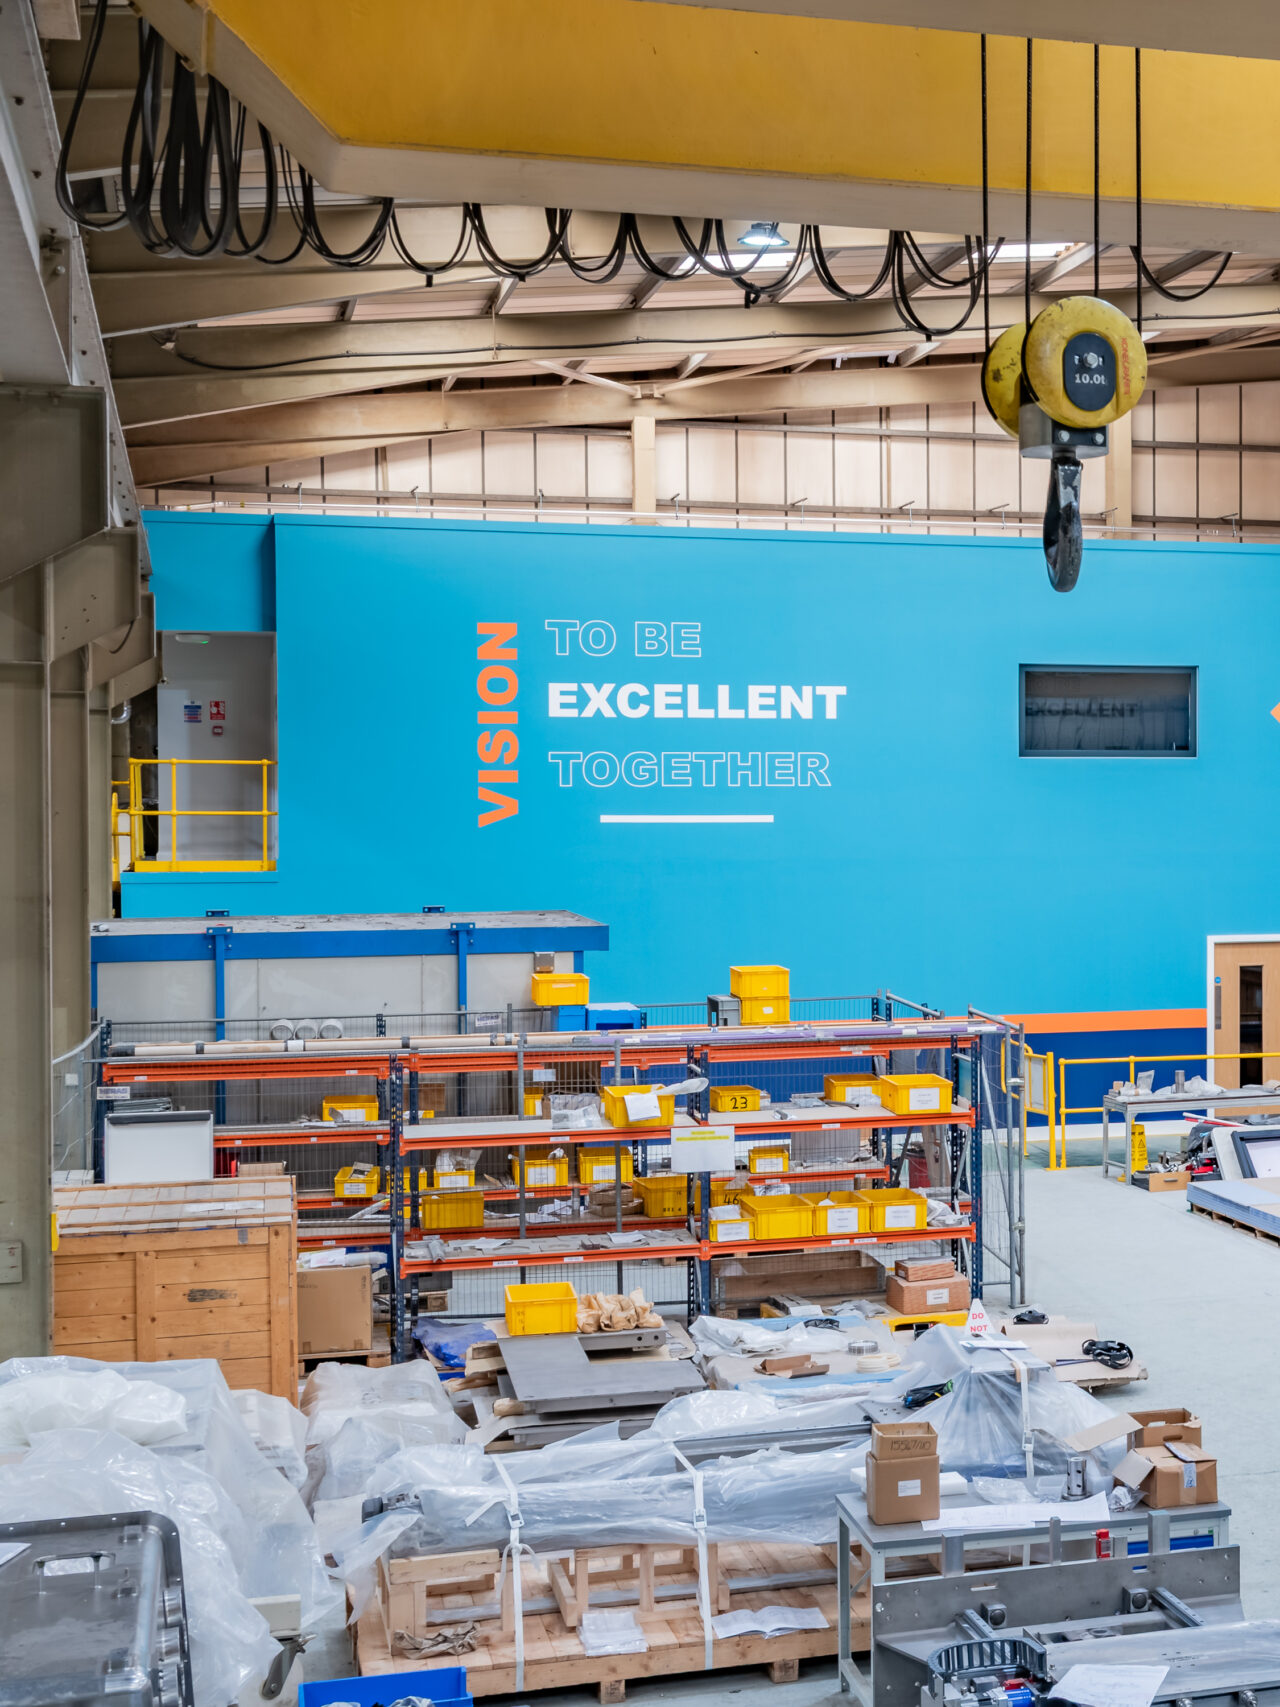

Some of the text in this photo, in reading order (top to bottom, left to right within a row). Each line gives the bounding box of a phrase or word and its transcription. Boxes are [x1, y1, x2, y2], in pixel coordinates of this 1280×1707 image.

[1075, 373, 1106, 385] 10.0t
[544, 619, 702, 657] TO BE
[548, 682, 847, 720] EXCELLENT
[477, 622, 519, 828] VISION
[548, 751, 832, 787] TOGETHER
[730, 1096, 748, 1109] 23
[723, 1193, 739, 1205] 46
[972, 1312, 984, 1320] DO
[970, 1324, 987, 1333] NOT
